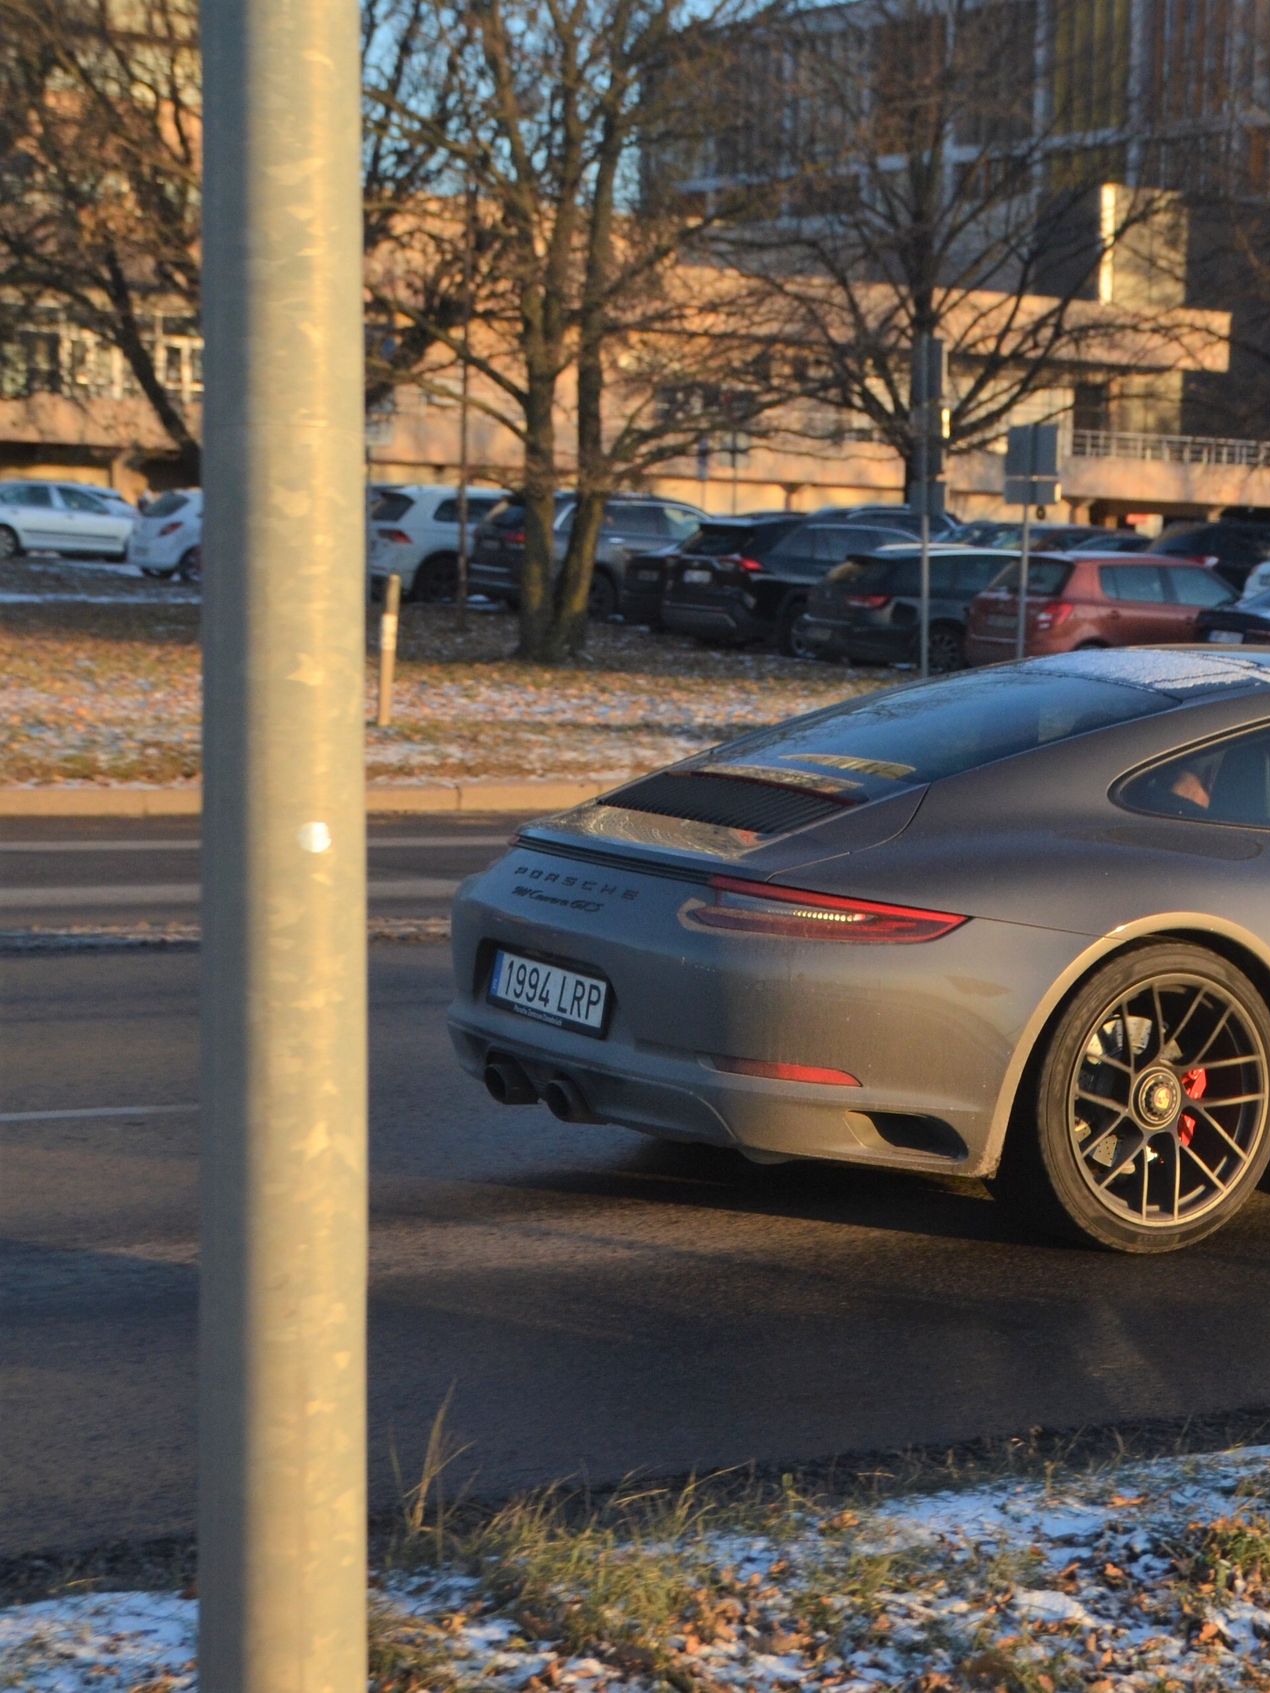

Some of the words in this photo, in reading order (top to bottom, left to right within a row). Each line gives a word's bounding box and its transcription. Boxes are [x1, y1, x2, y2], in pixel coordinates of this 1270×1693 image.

[514, 866, 640, 900] PORSCHE
[505, 960, 552, 1008] 1994
[557, 975, 602, 1021] LRP
